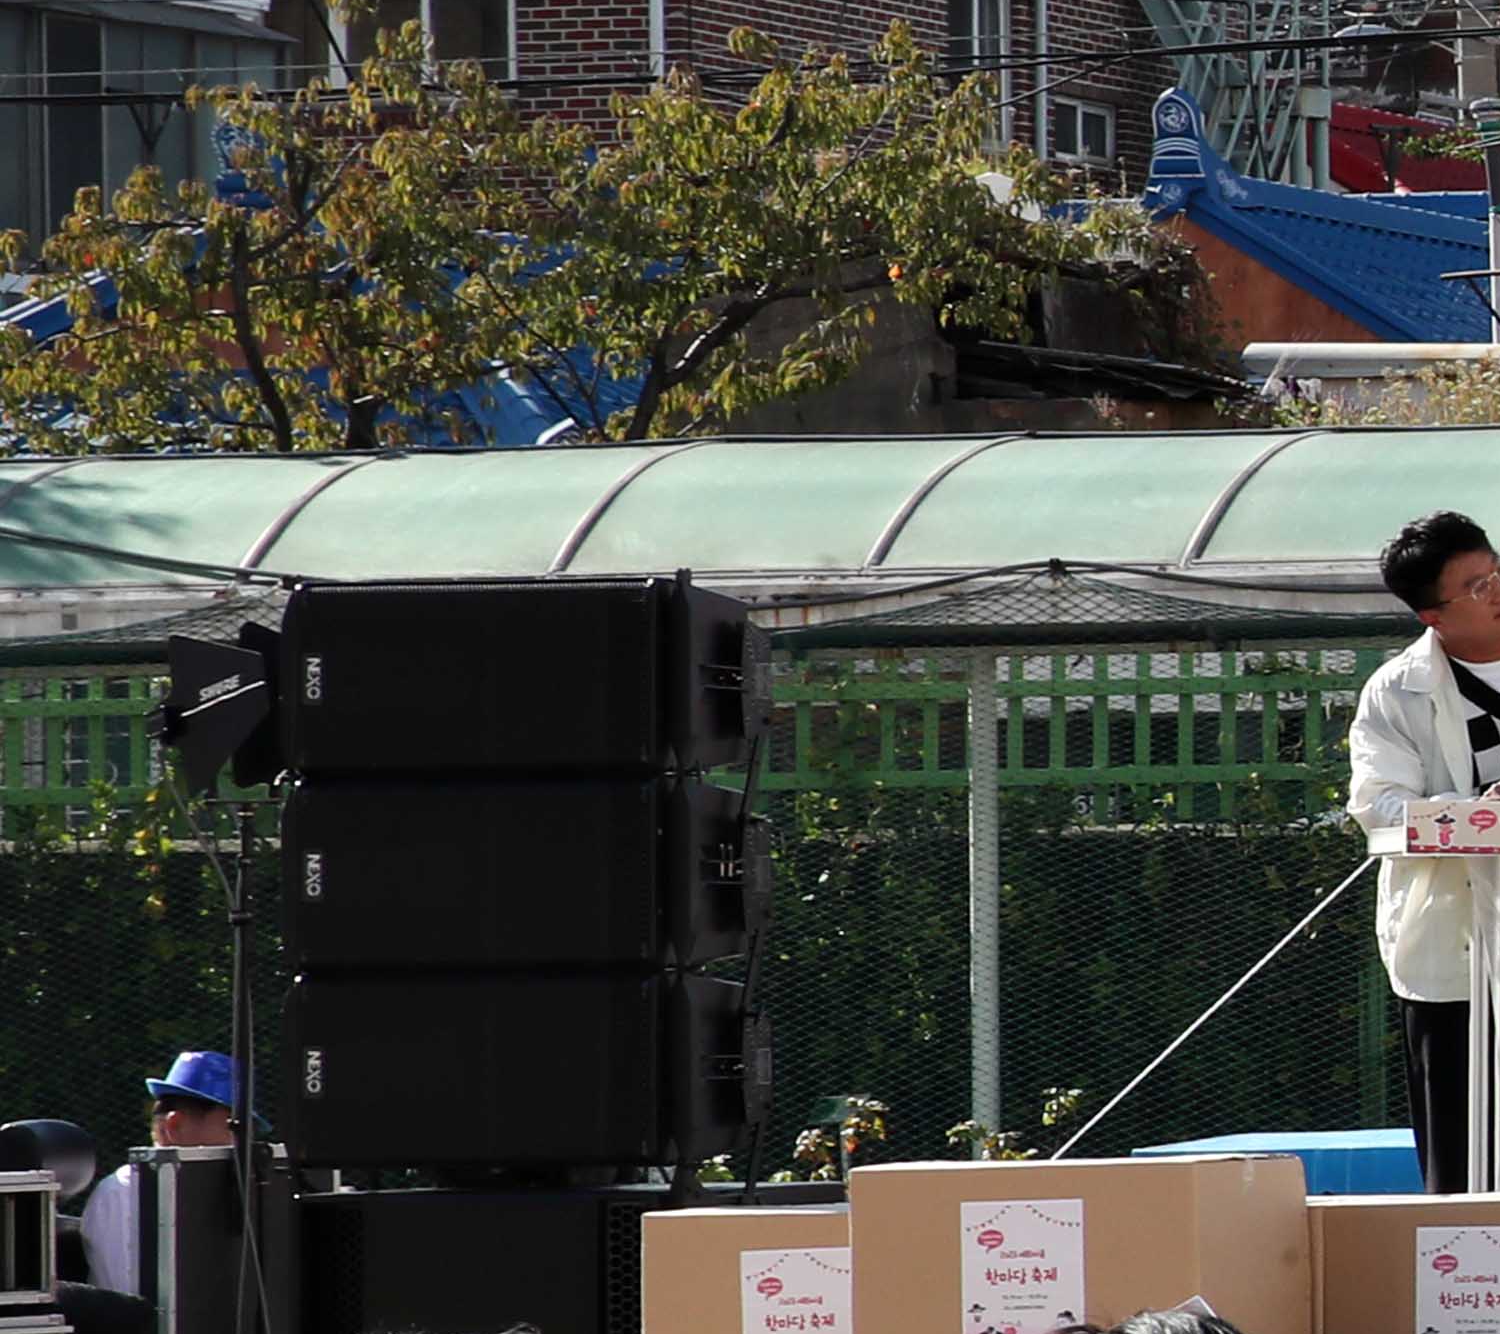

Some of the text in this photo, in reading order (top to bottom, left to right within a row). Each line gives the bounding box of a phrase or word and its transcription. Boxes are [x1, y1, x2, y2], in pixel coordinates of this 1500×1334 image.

[306, 656, 322, 700] NEXO
[306, 853, 322, 897] NEXO
[306, 1050, 322, 1094] NEXO
[984, 1266, 1058, 1286] 한마당 축제
[1438, 1291, 1480, 1310] 한마당
[764, 1313, 807, 1332] 한마당
